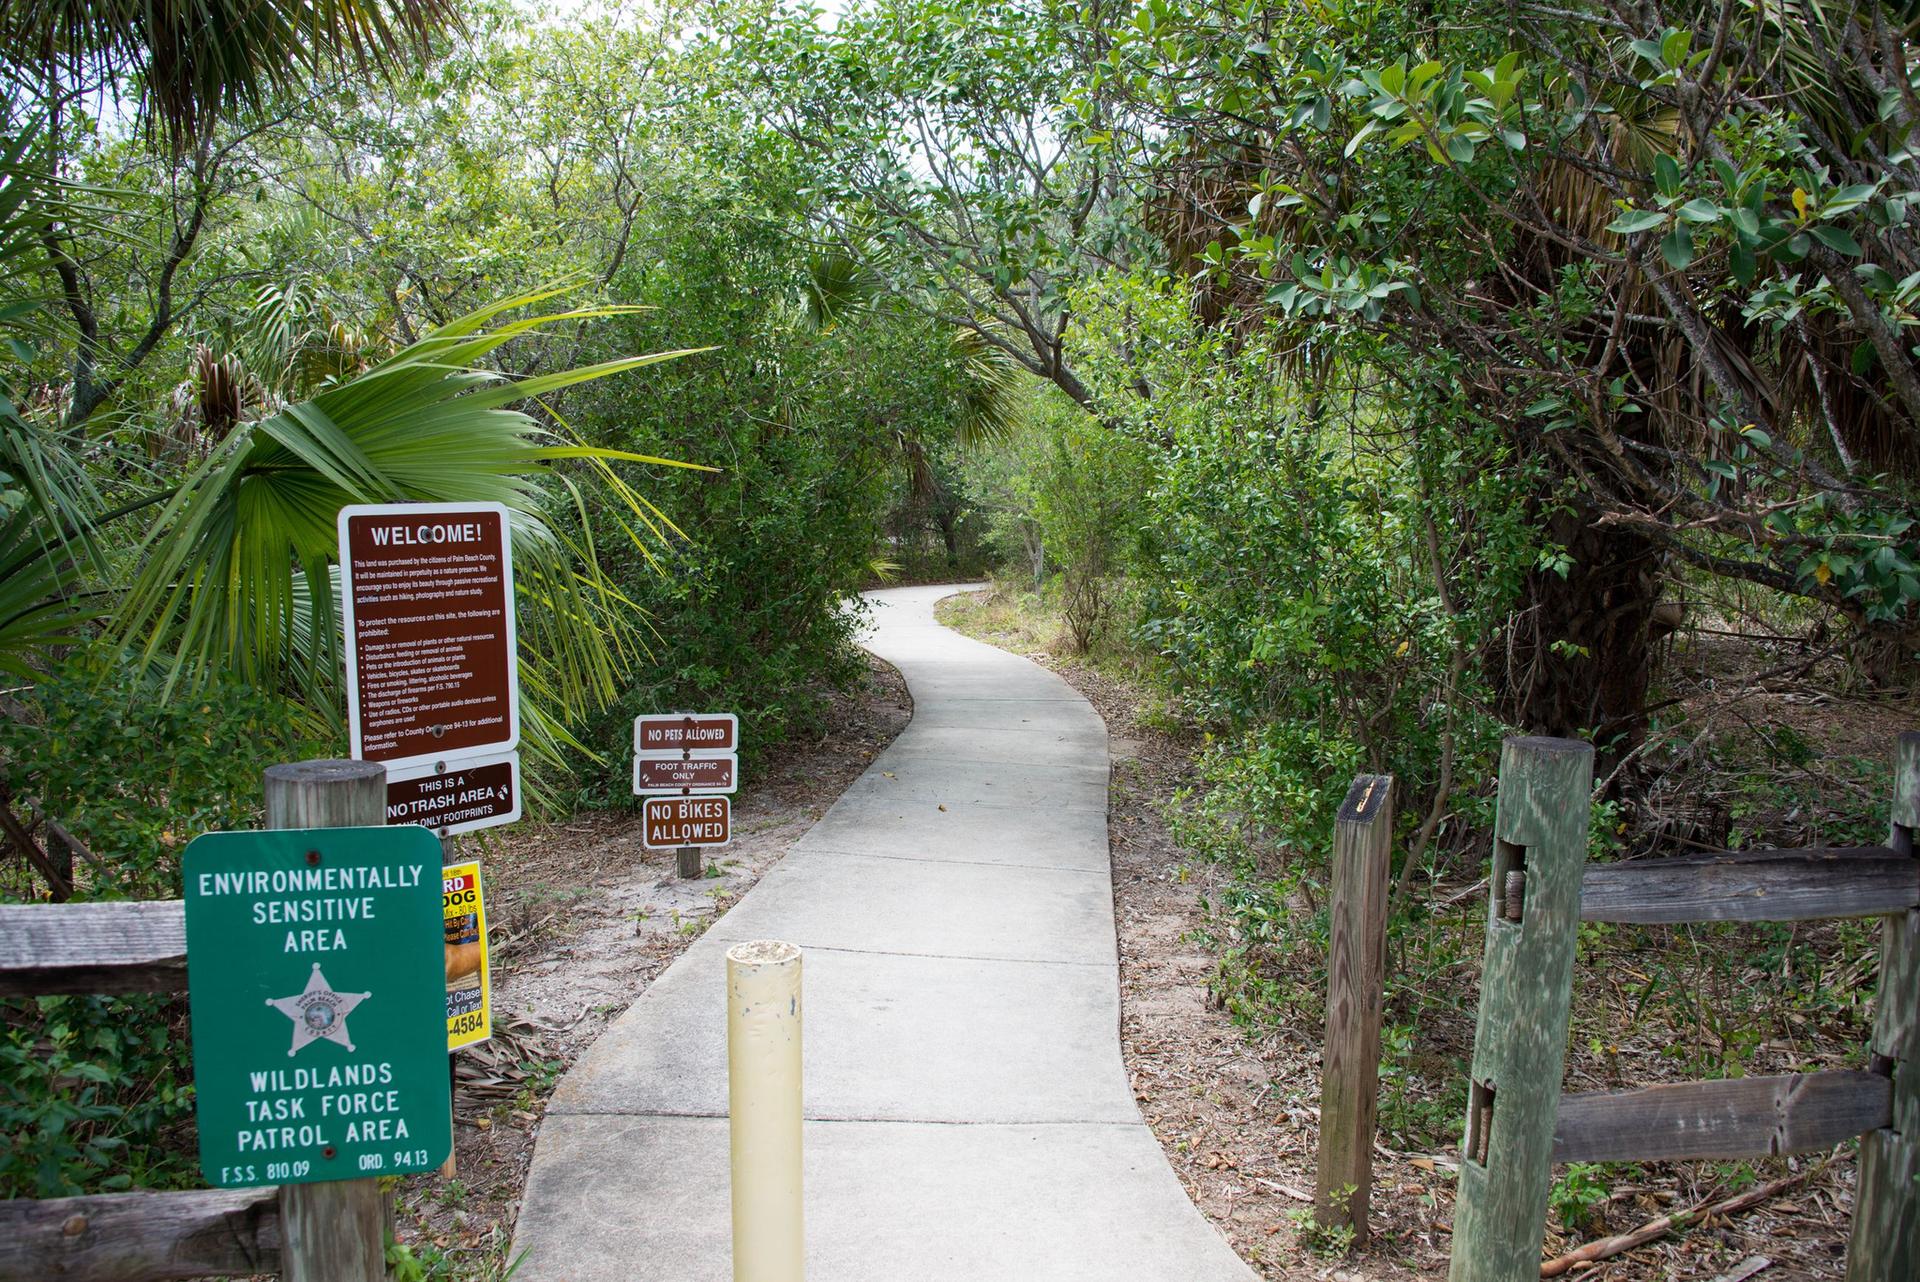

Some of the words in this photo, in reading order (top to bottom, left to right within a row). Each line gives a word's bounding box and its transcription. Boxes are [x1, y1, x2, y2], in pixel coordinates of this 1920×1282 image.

[371, 524, 481, 546] WELCOME!
[354, 560, 365, 568] This
[388, 558, 412, 567] purchased
[414, 558, 419, 566] by
[409, 568, 432, 578] perpetuity
[356, 584, 382, 592] encourage
[419, 580, 434, 588] beauty
[435, 579, 453, 587] through
[454, 578, 471, 586] passive
[416, 591, 444, 600] photography
[366, 618, 386, 627] protect
[393, 659, 421, 667] introduction
[432, 664, 459, 672] skateboards
[429, 674, 449, 682] alcoholic
[432, 701, 450, 710] portable
[369, 719, 394, 727] earphones
[478, 716, 502, 725] additional
[649, 730, 661, 741] NO
[665, 729, 682, 740] PETS
[686, 729, 724, 740] ALLOWED
[418, 780, 442, 793] THIS
[445, 778, 454, 788] IS
[458, 776, 464, 786] A
[388, 804, 408, 818] NO
[409, 794, 454, 814] TRASH
[459, 786, 494, 804] AREA
[420, 815, 441, 828] ONLY
[444, 805, 493, 822] FOOTPRINTS
[652, 805, 671, 820] NO
[680, 803, 722, 818] BIKES
[652, 823, 723, 840] ALLOWED
[200, 865, 424, 896] ENVIRONMENTALLY
[253, 897, 375, 924] SENSITIVE
[284, 929, 347, 953] AREA
[447, 1006, 459, 1017] Call
[461, 1006, 468, 1014] or
[469, 1000, 482, 1011] Text
[250, 1063, 392, 1093] WILDLANDS
[246, 1098, 305, 1122] TASK
[321, 1090, 399, 1116] FORCE
[238, 1124, 329, 1151] PATROL
[346, 1118, 409, 1143] AREA
[267, 1161, 310, 1179] 810.09
[359, 1154, 386, 1170] ORD.
[394, 1150, 428, 1167] 94.13
